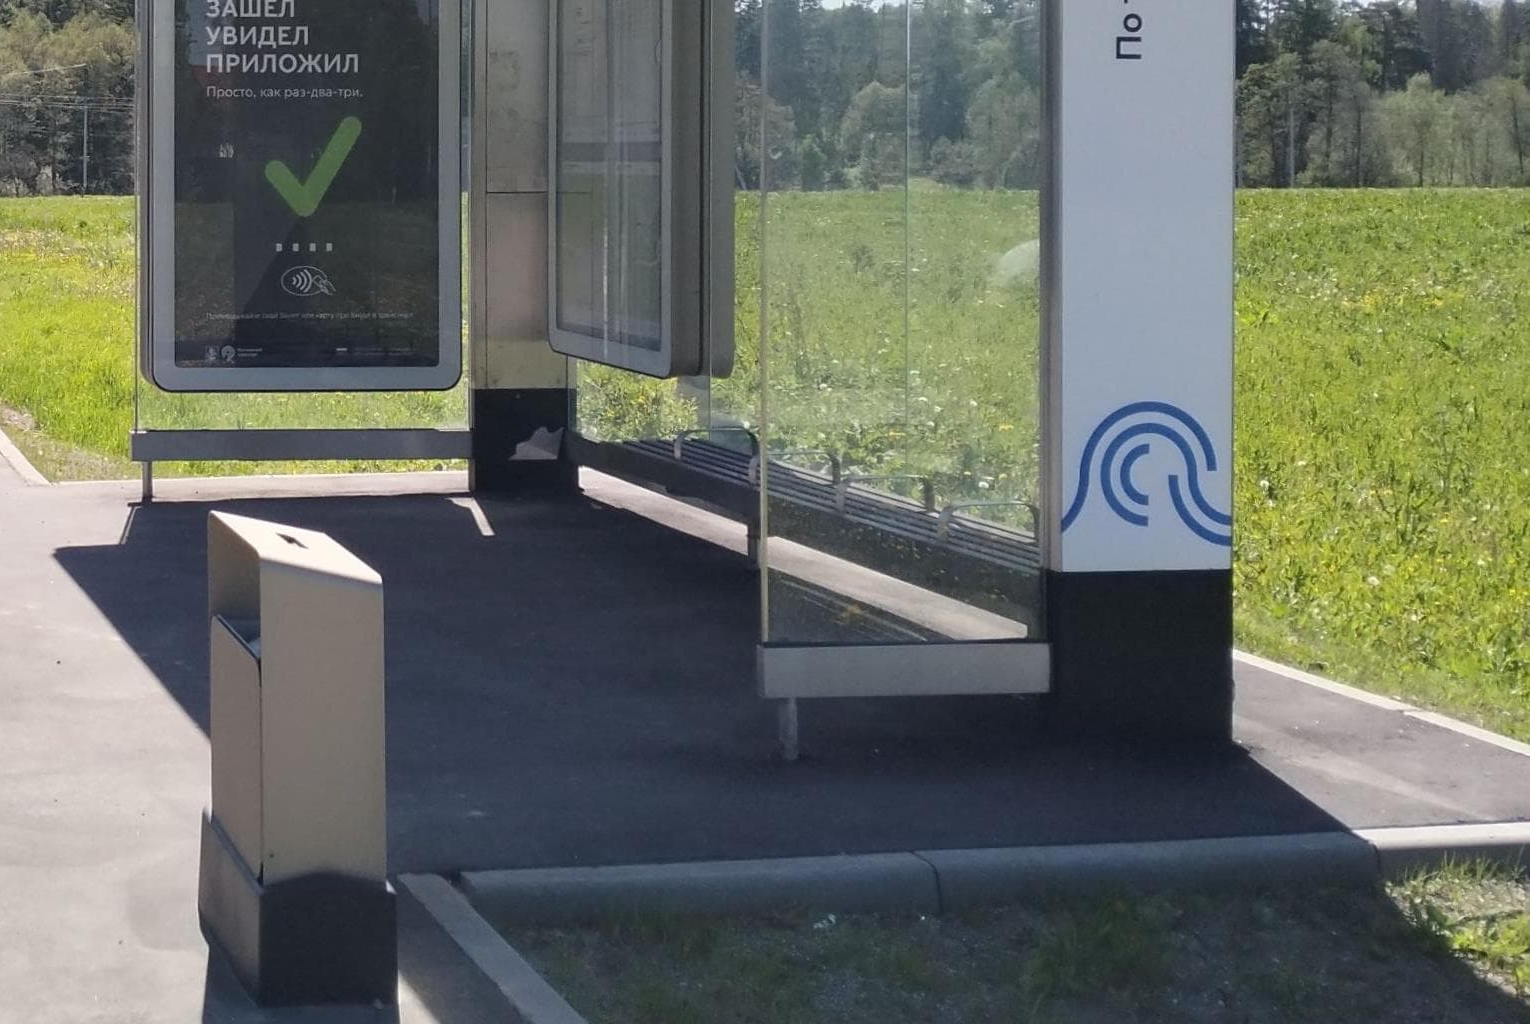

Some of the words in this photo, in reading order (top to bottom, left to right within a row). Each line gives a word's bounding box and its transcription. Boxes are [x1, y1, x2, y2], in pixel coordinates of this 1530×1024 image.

[205, 25, 309, 49] УВИДЕЛ
[1116, 13, 1142, 59] По
[206, 53, 359, 73] ПРИЛОЖИЛ
[206, 85, 256, 100] Просто,
[260, 87, 281, 98] как
[284, 87, 364, 100] раз-два-три.
